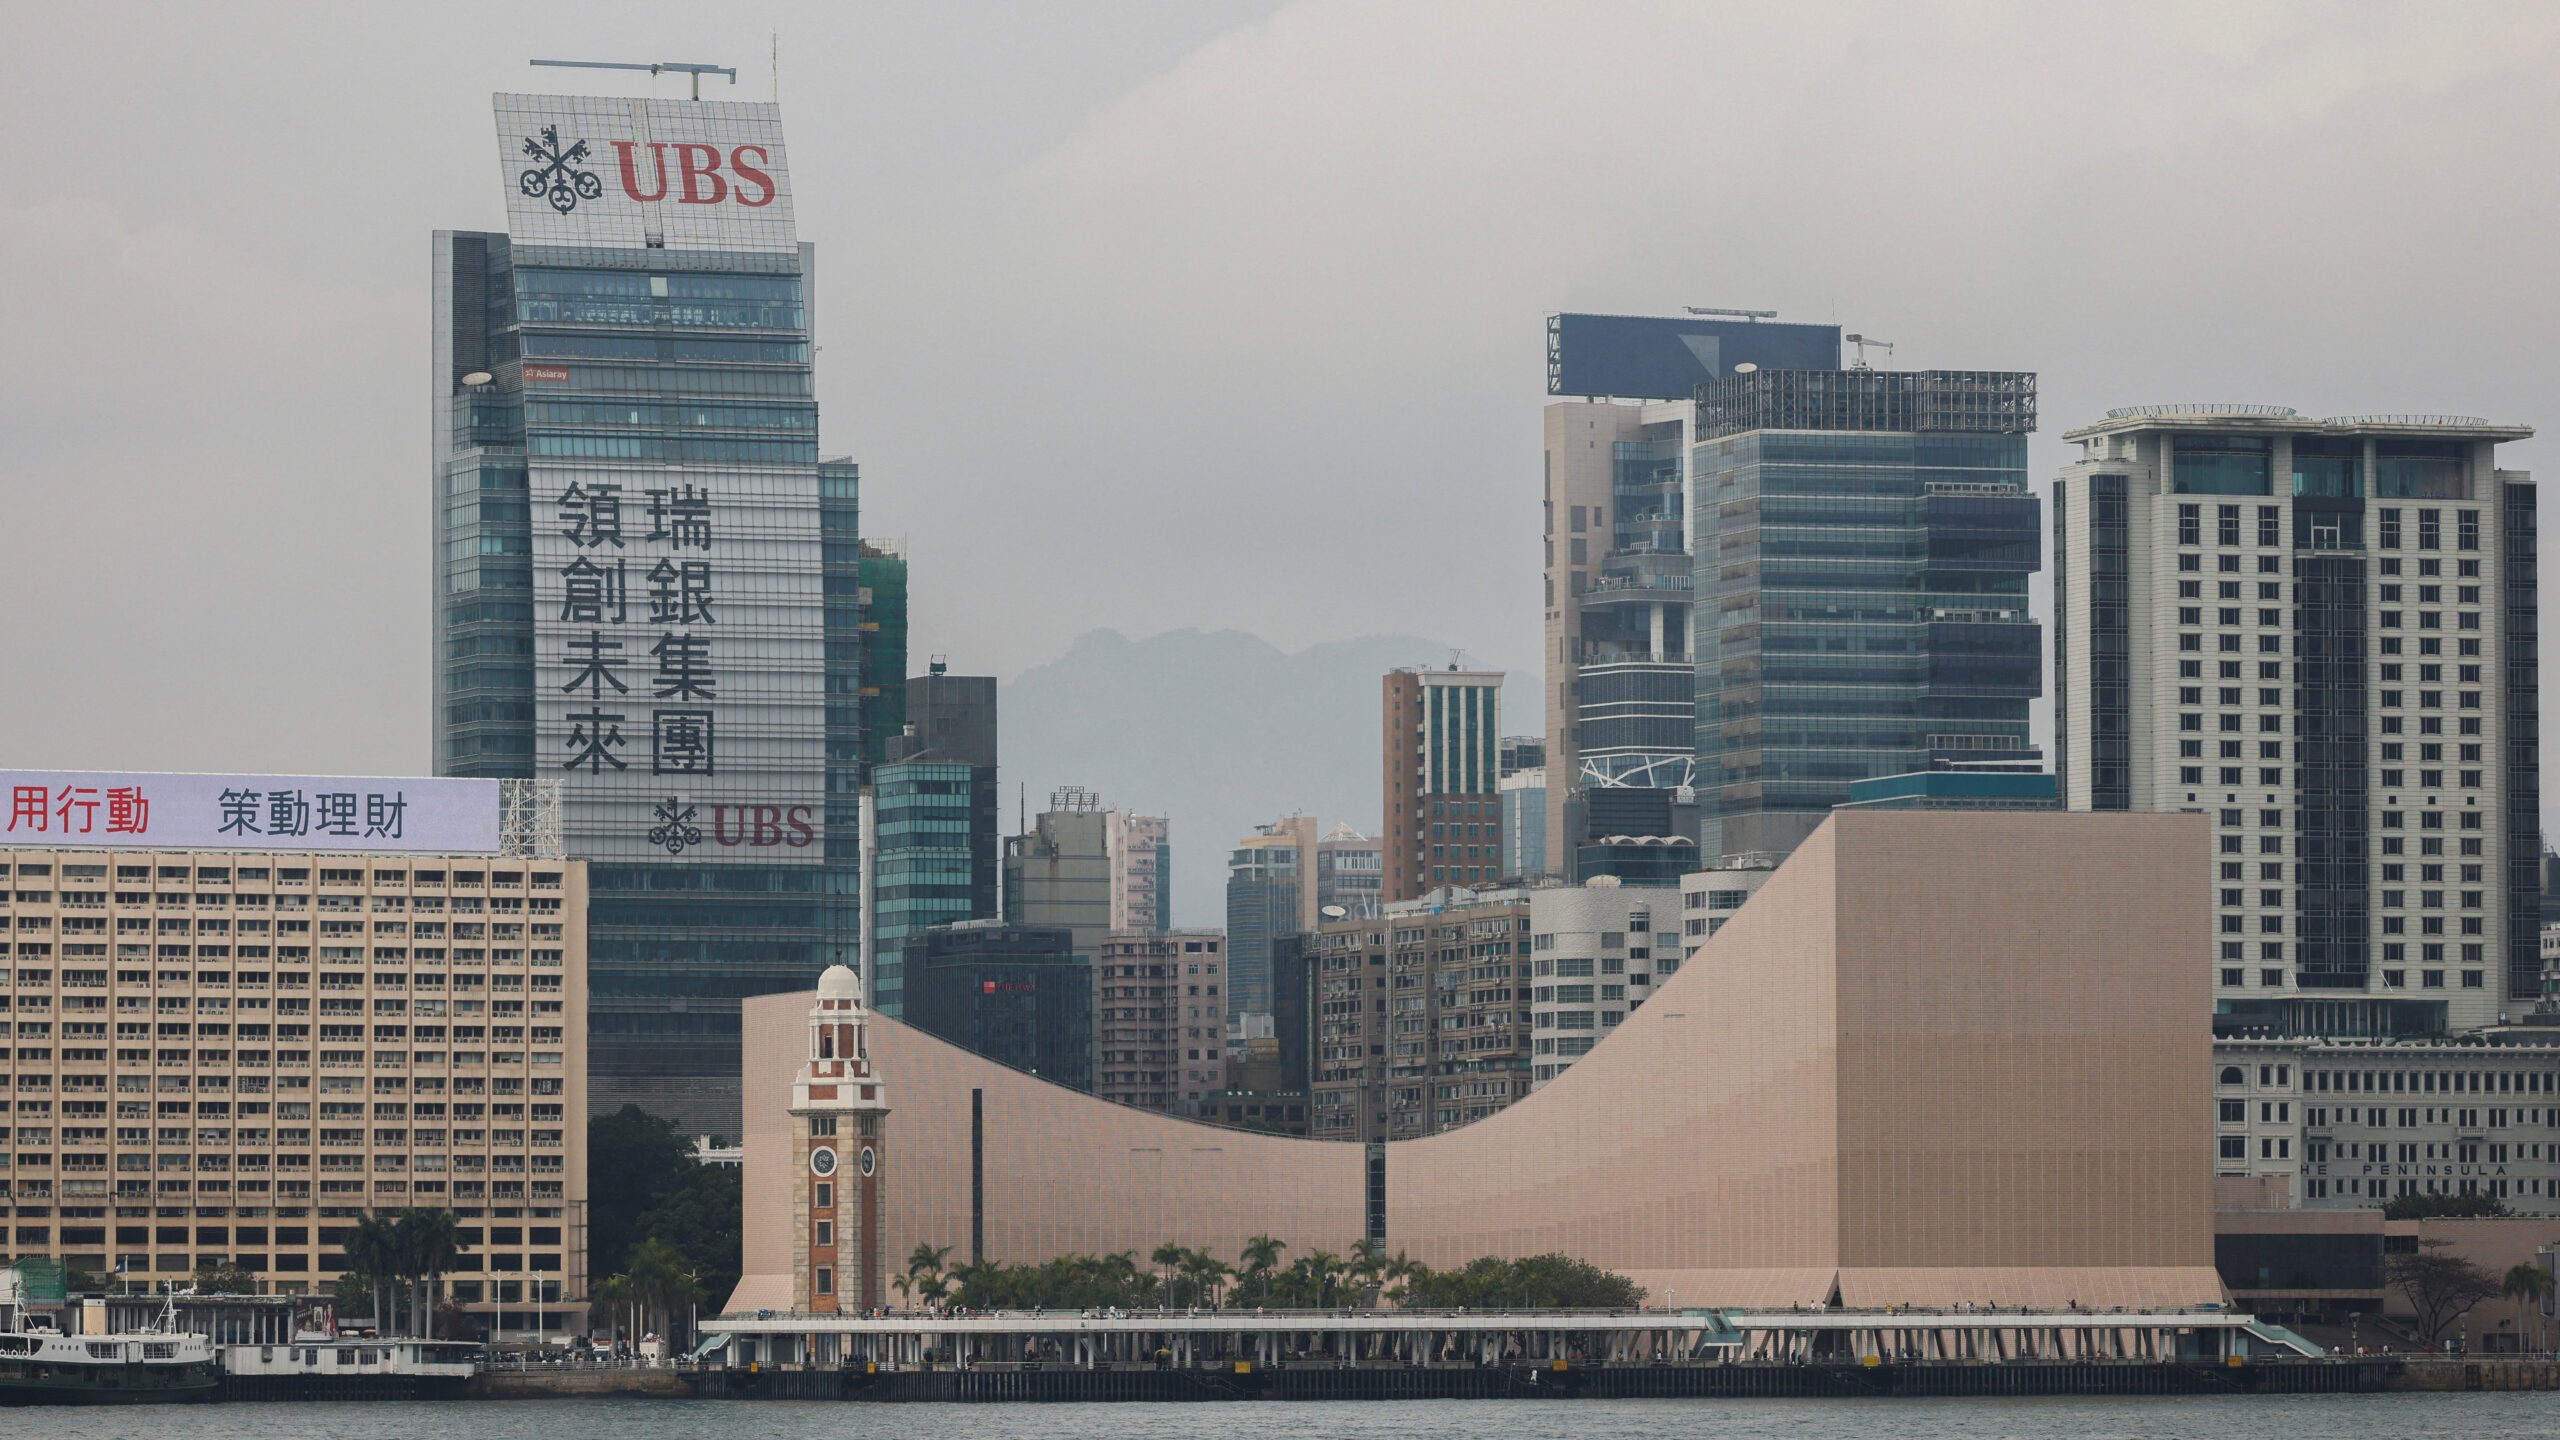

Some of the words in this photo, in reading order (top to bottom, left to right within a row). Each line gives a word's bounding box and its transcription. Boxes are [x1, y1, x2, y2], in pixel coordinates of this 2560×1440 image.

[610, 141, 775, 207] UBS
[536, 369, 567, 380] Asiaray
[558, 481, 629, 775] 領創未來
[645, 483, 716, 776] 瑞銀集團
[7, 784, 149, 834] 用行動
[217, 787, 408, 839] 策動理財
[711, 805, 814, 847] UBS
[2301, 1165, 2327, 1175] HE
[2363, 1165, 2506, 1175] PENINSULA
